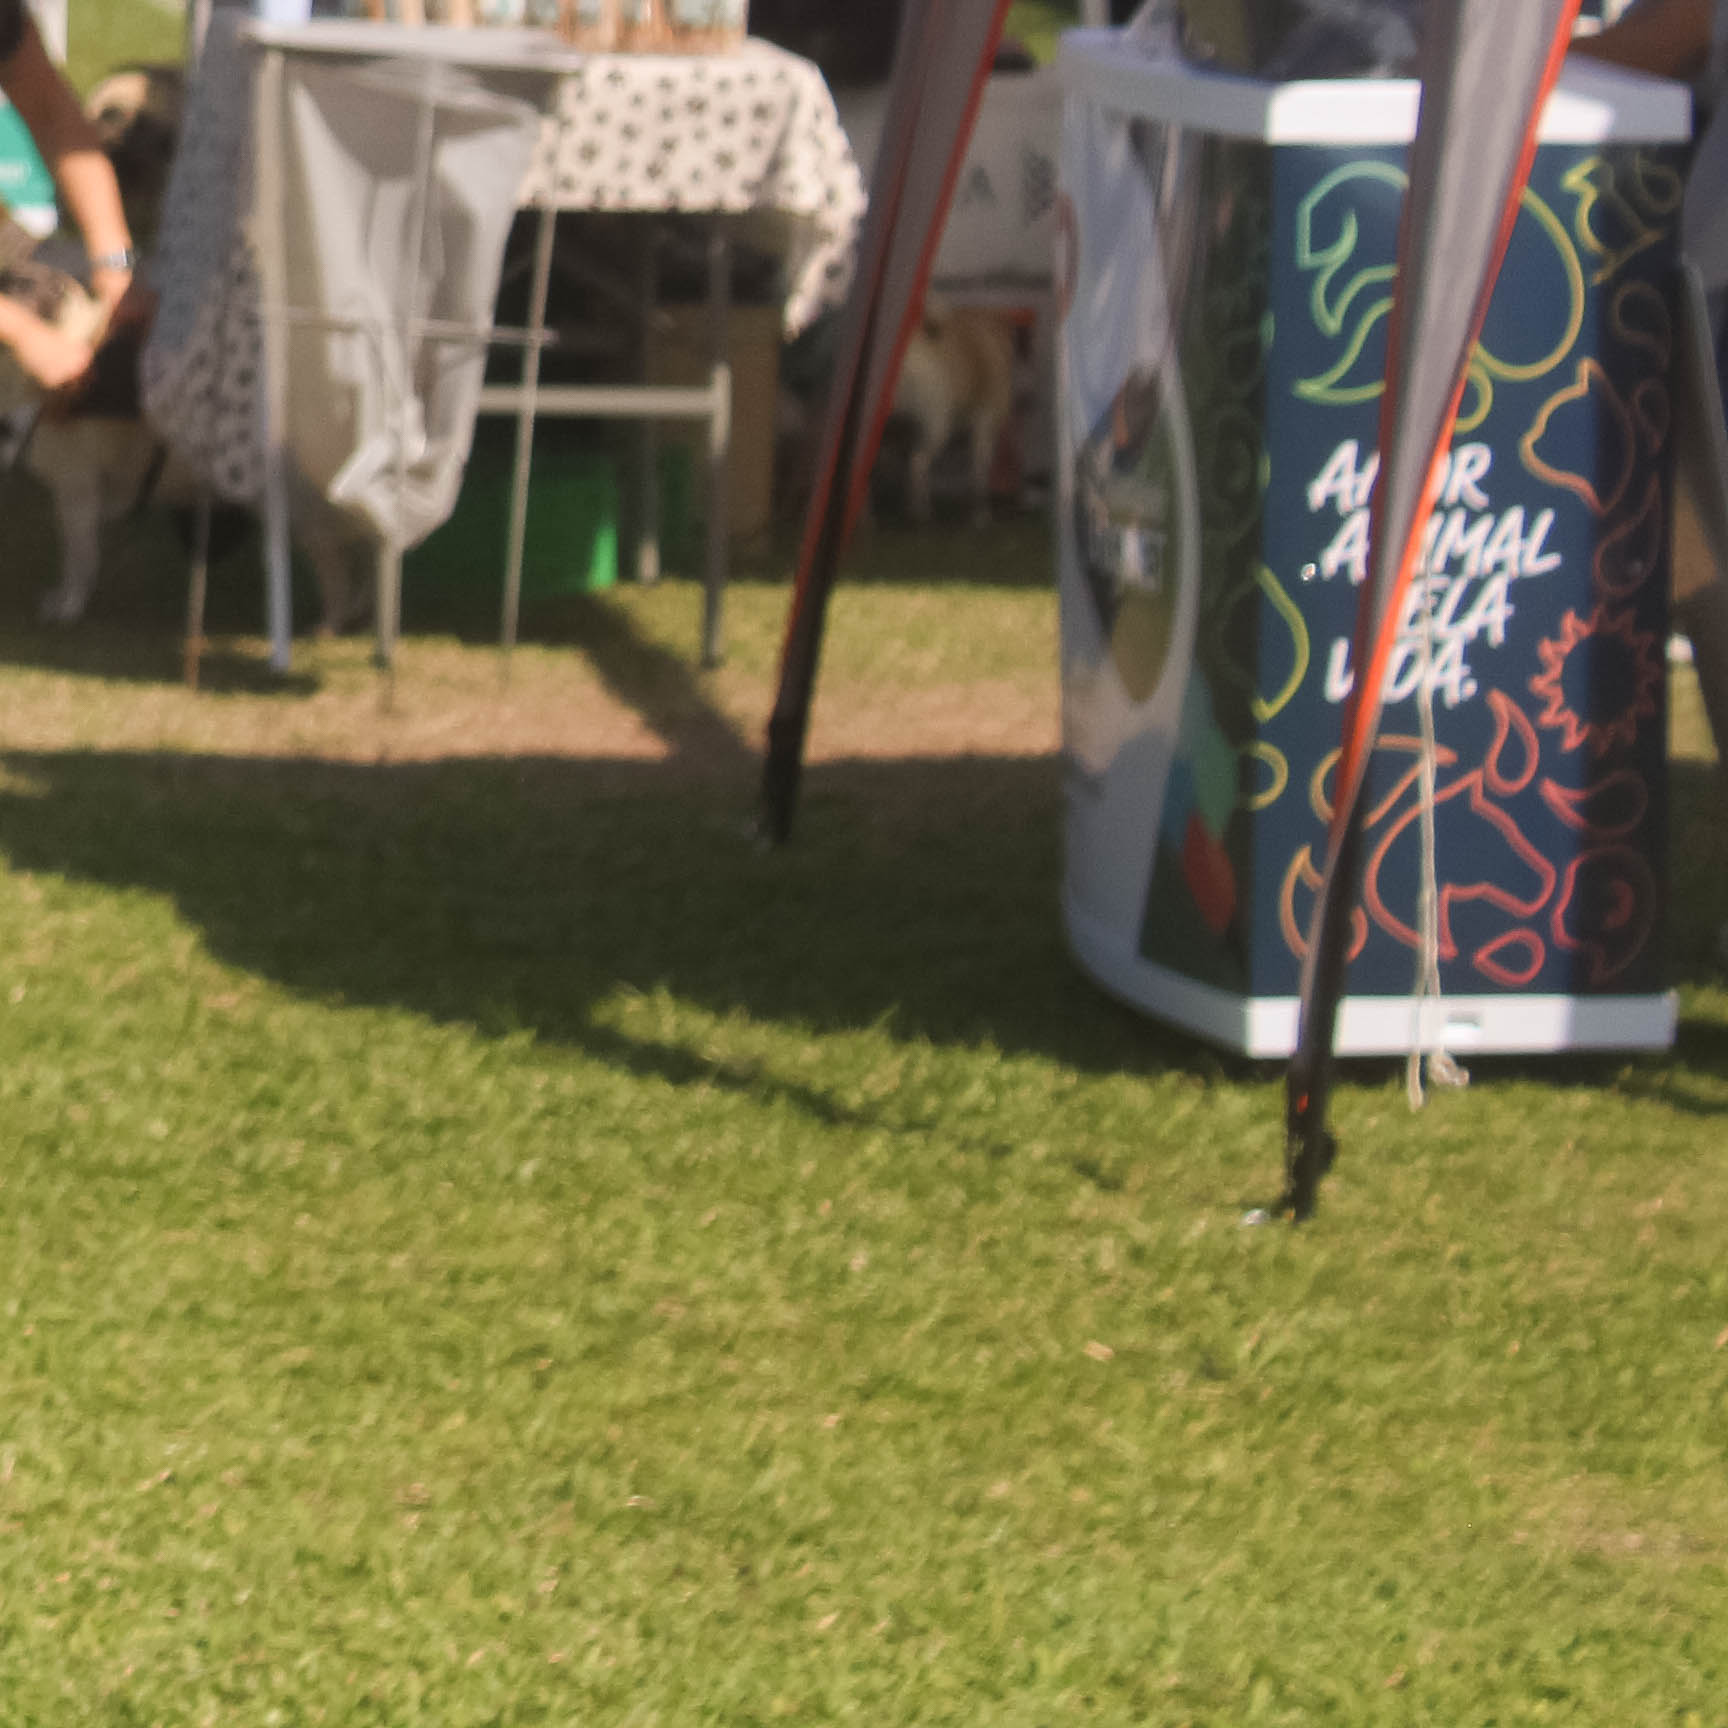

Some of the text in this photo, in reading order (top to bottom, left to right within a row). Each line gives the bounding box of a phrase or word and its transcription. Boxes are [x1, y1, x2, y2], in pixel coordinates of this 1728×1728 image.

[1307, 439, 1492, 515] AR
[1320, 504, 1562, 586] AIMAL
[1396, 570, 1515, 648] ELA
